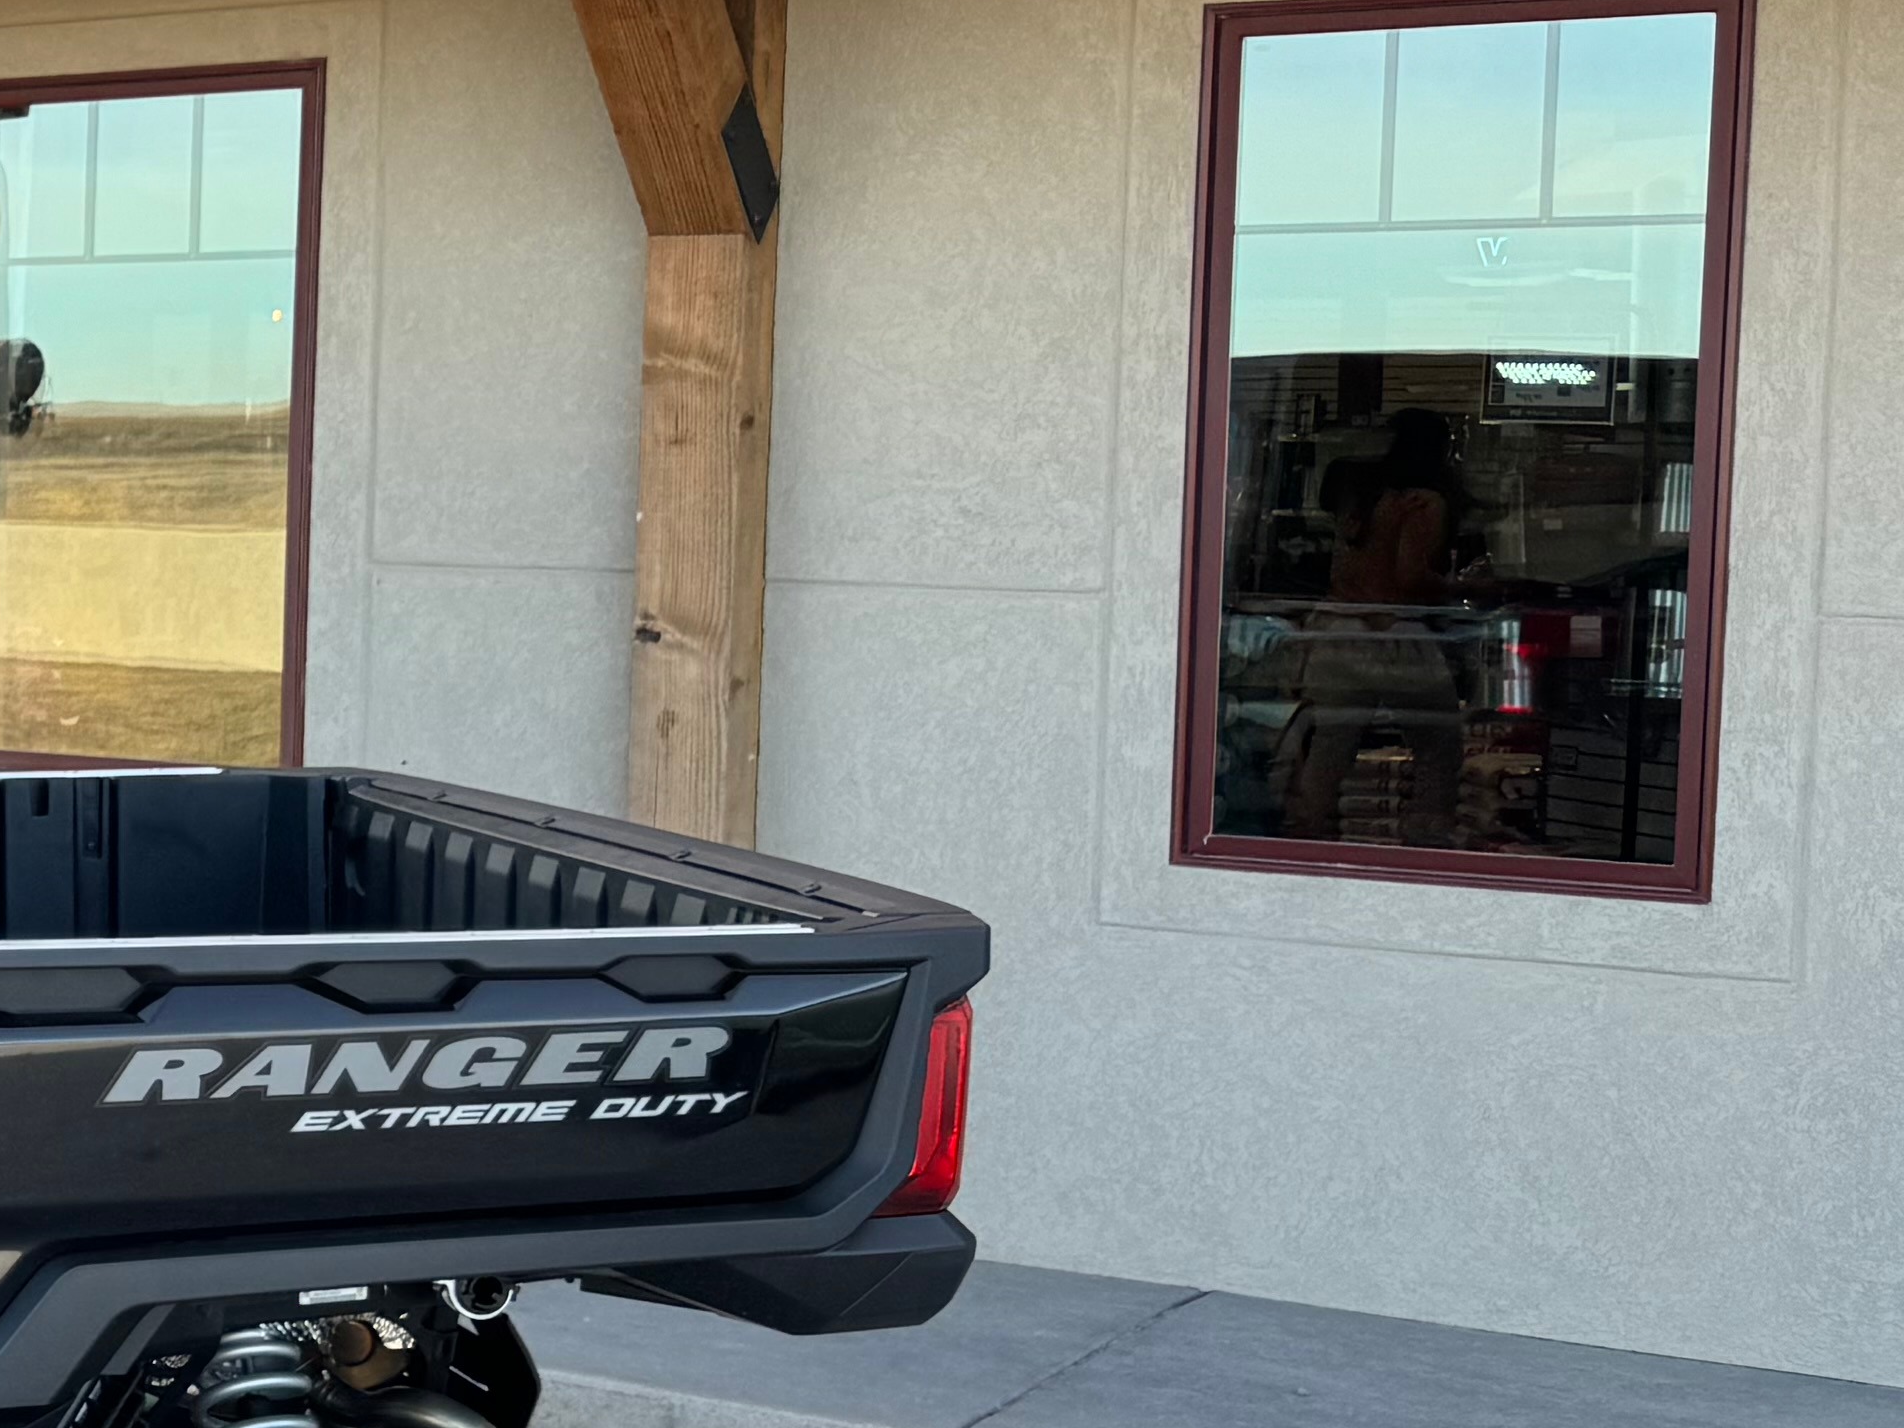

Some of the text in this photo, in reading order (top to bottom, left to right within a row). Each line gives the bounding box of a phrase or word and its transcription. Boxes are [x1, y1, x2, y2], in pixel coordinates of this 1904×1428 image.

[98, 1025, 731, 1105] RANGER
[290, 1090, 748, 1134] EXTREME DUTY
